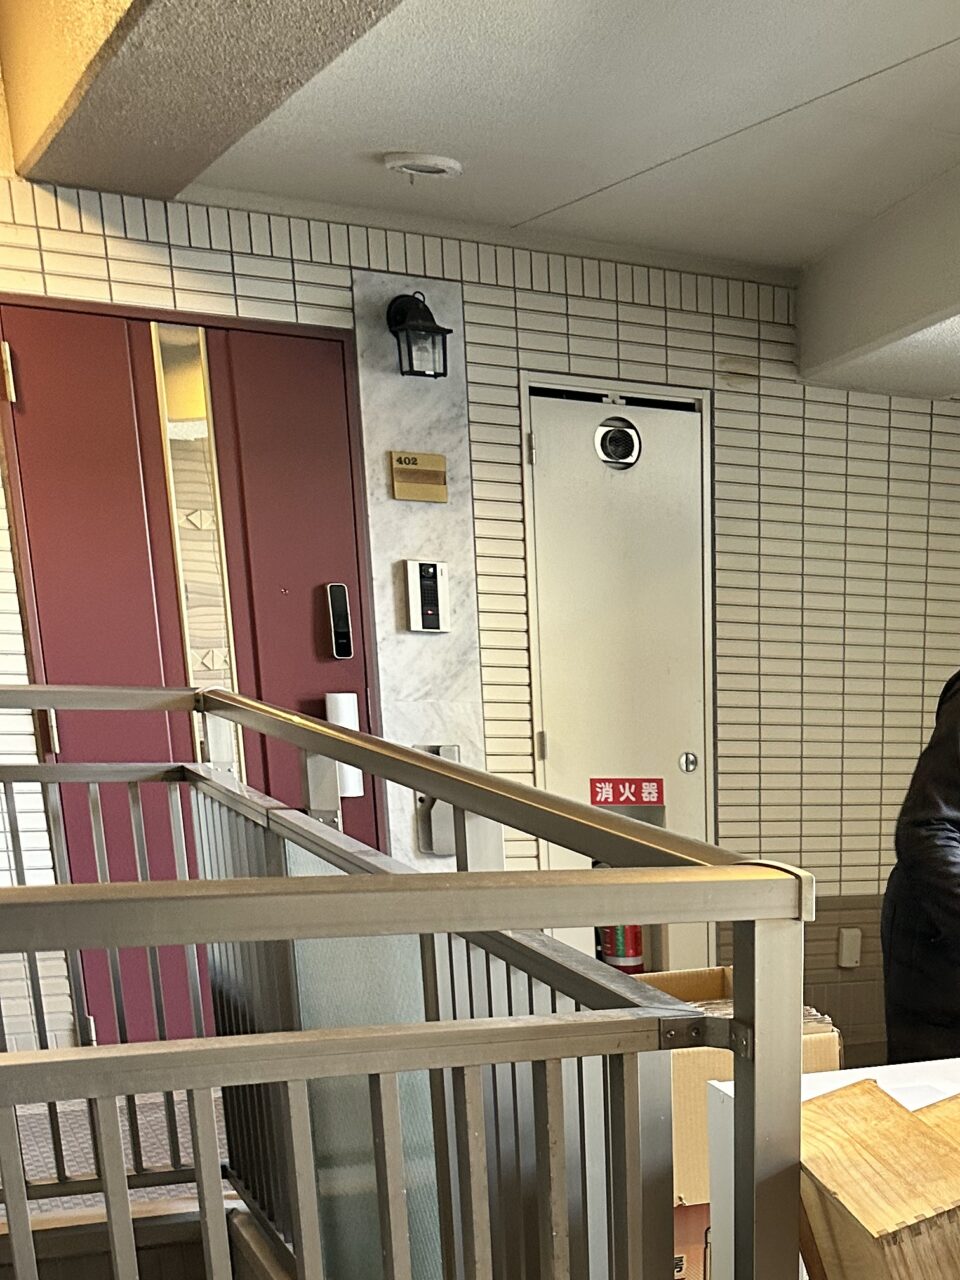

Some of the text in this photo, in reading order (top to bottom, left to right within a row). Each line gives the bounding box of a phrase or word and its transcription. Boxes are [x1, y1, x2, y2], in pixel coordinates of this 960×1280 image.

[396, 456, 418, 466] 402
[595, 782, 658, 802] 消火器
